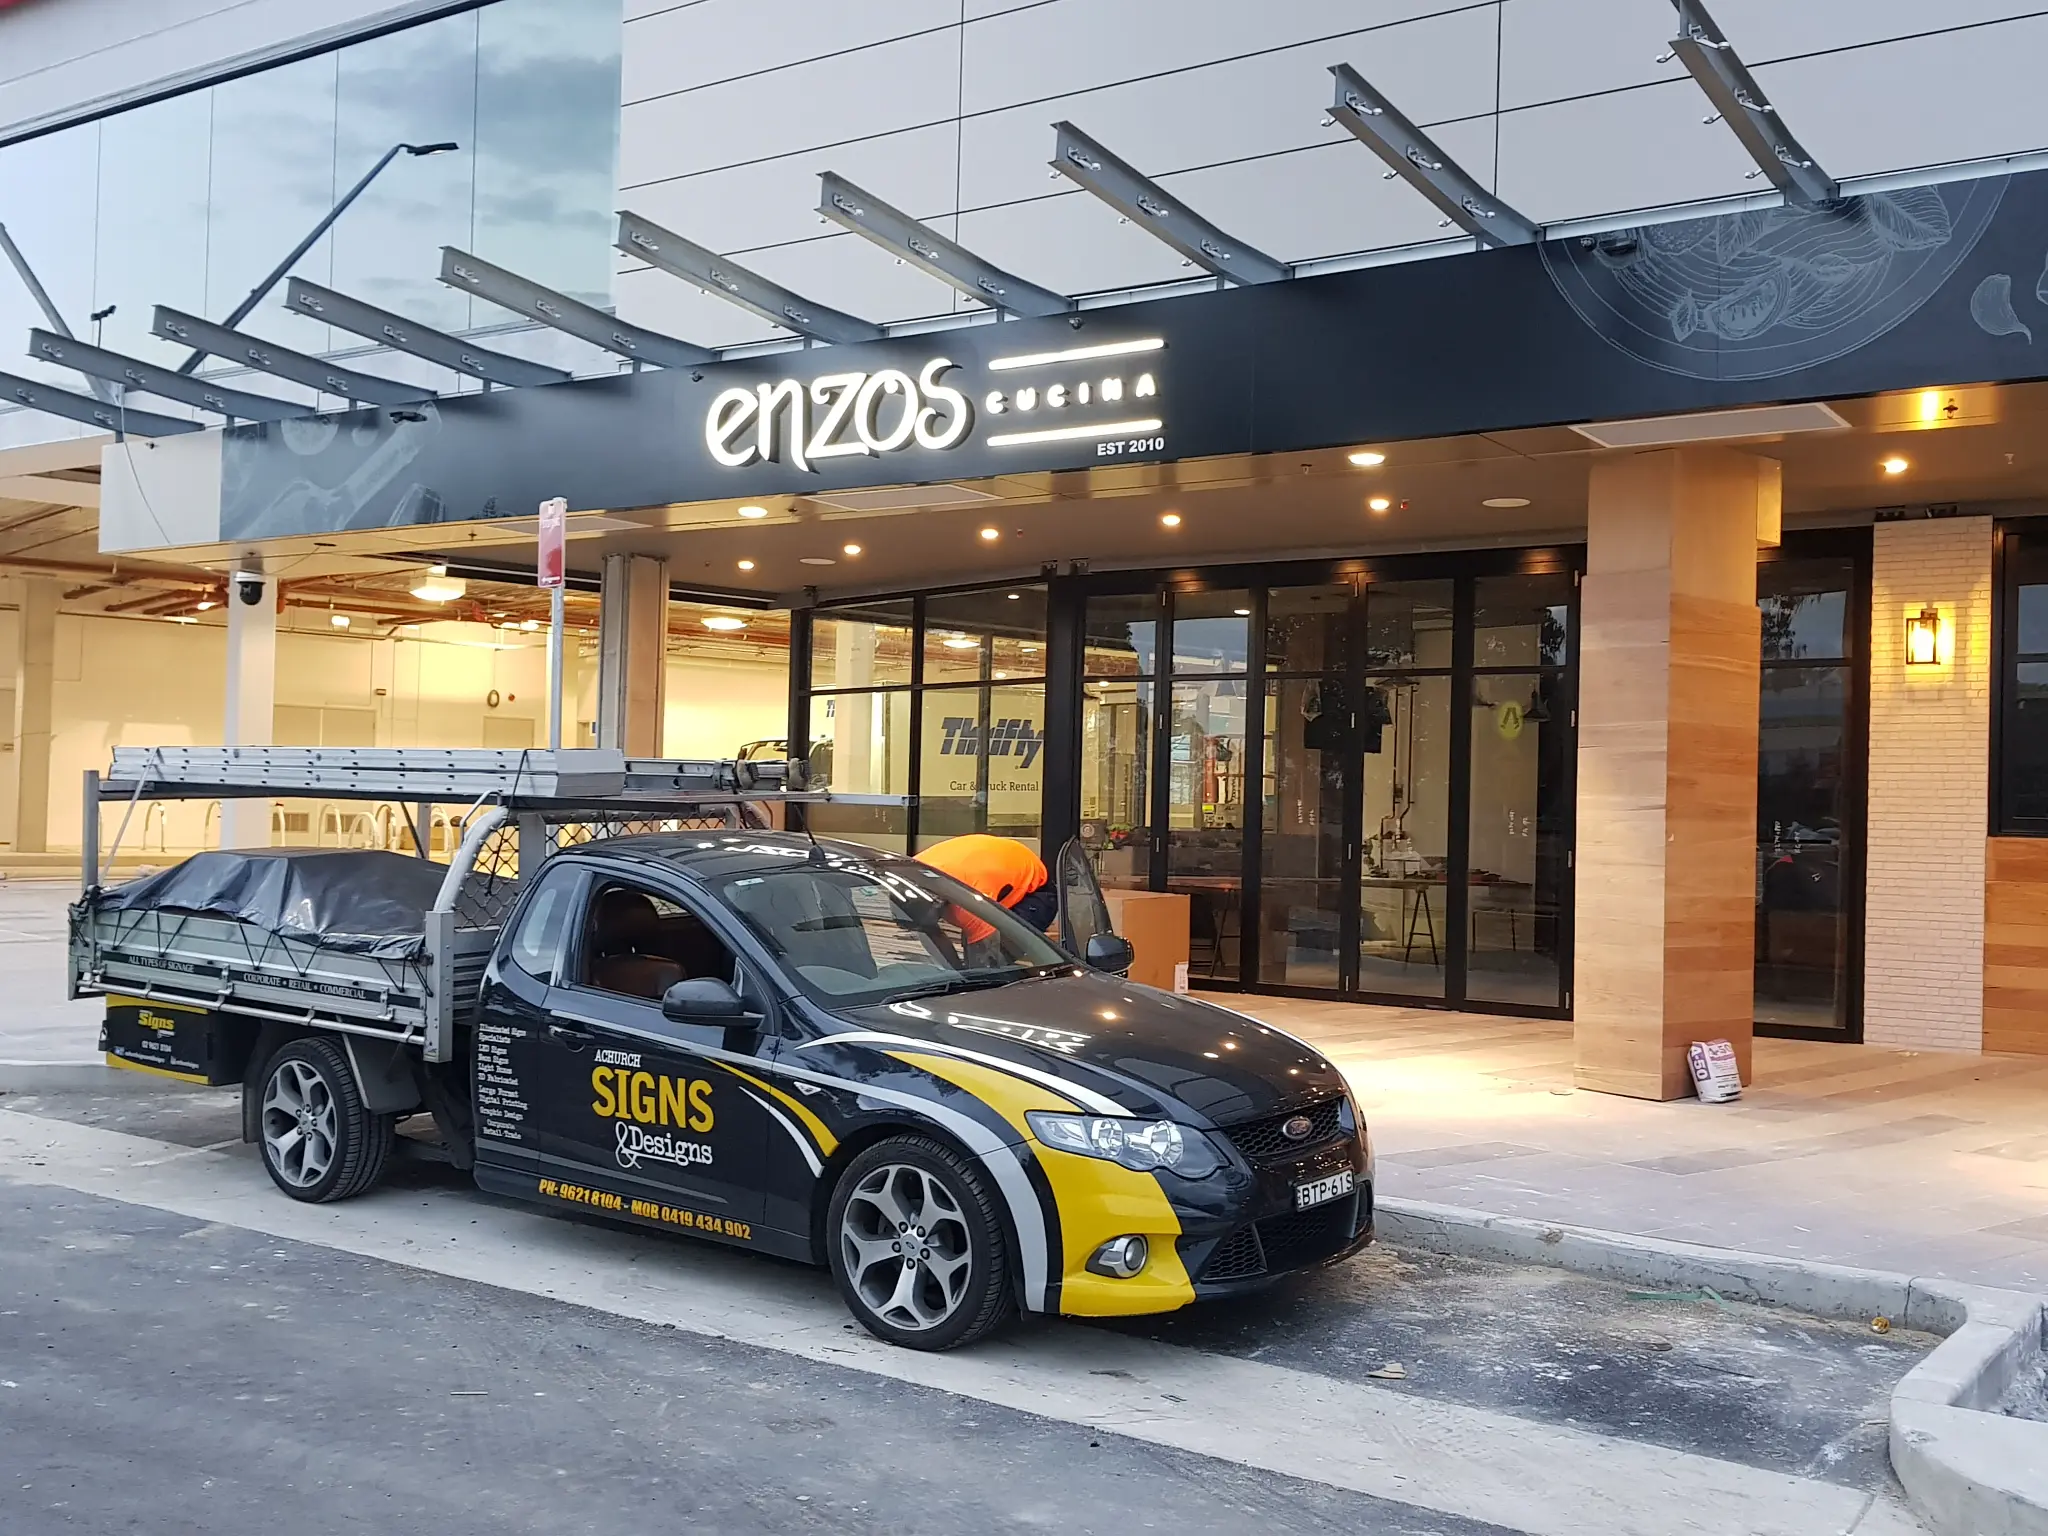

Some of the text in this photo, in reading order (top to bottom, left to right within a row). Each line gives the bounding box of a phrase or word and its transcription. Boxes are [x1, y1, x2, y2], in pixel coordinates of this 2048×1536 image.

[985, 373, 1160, 415] CUCINA
[706, 357, 973, 473] enzos
[1097, 437, 1165, 457] EST 2010
[949, 781, 967, 791] Car
[989, 781, 1007, 791] uck
[1009, 781, 1039, 792] Rental
[128, 956, 140, 965] ALL
[141, 958, 159, 968] TYPES
[168, 961, 195, 973] SIGNAGE
[243, 972, 366, 999] CORPORATE RETAIL COMMERCIAL
[138, 1012, 175, 1030] Signs
[477, 1062, 494, 1072] Light
[594, 1049, 641, 1068] ACHURCH
[478, 1084, 495, 1096] Large
[591, 1065, 715, 1133] SIGNS
[478, 1094, 527, 1111] Digital Printing
[503, 1110, 523, 1121] Design
[628, 1125, 713, 1167] Designs
[559, 1183, 591, 1204] 9621
[591, 1190, 622, 1211] 8104
[631, 1199, 659, 1219] MOB
[661, 1206, 693, 1227] 0419
[695, 1214, 723, 1233] 434
[724, 1220, 752, 1240] 902
